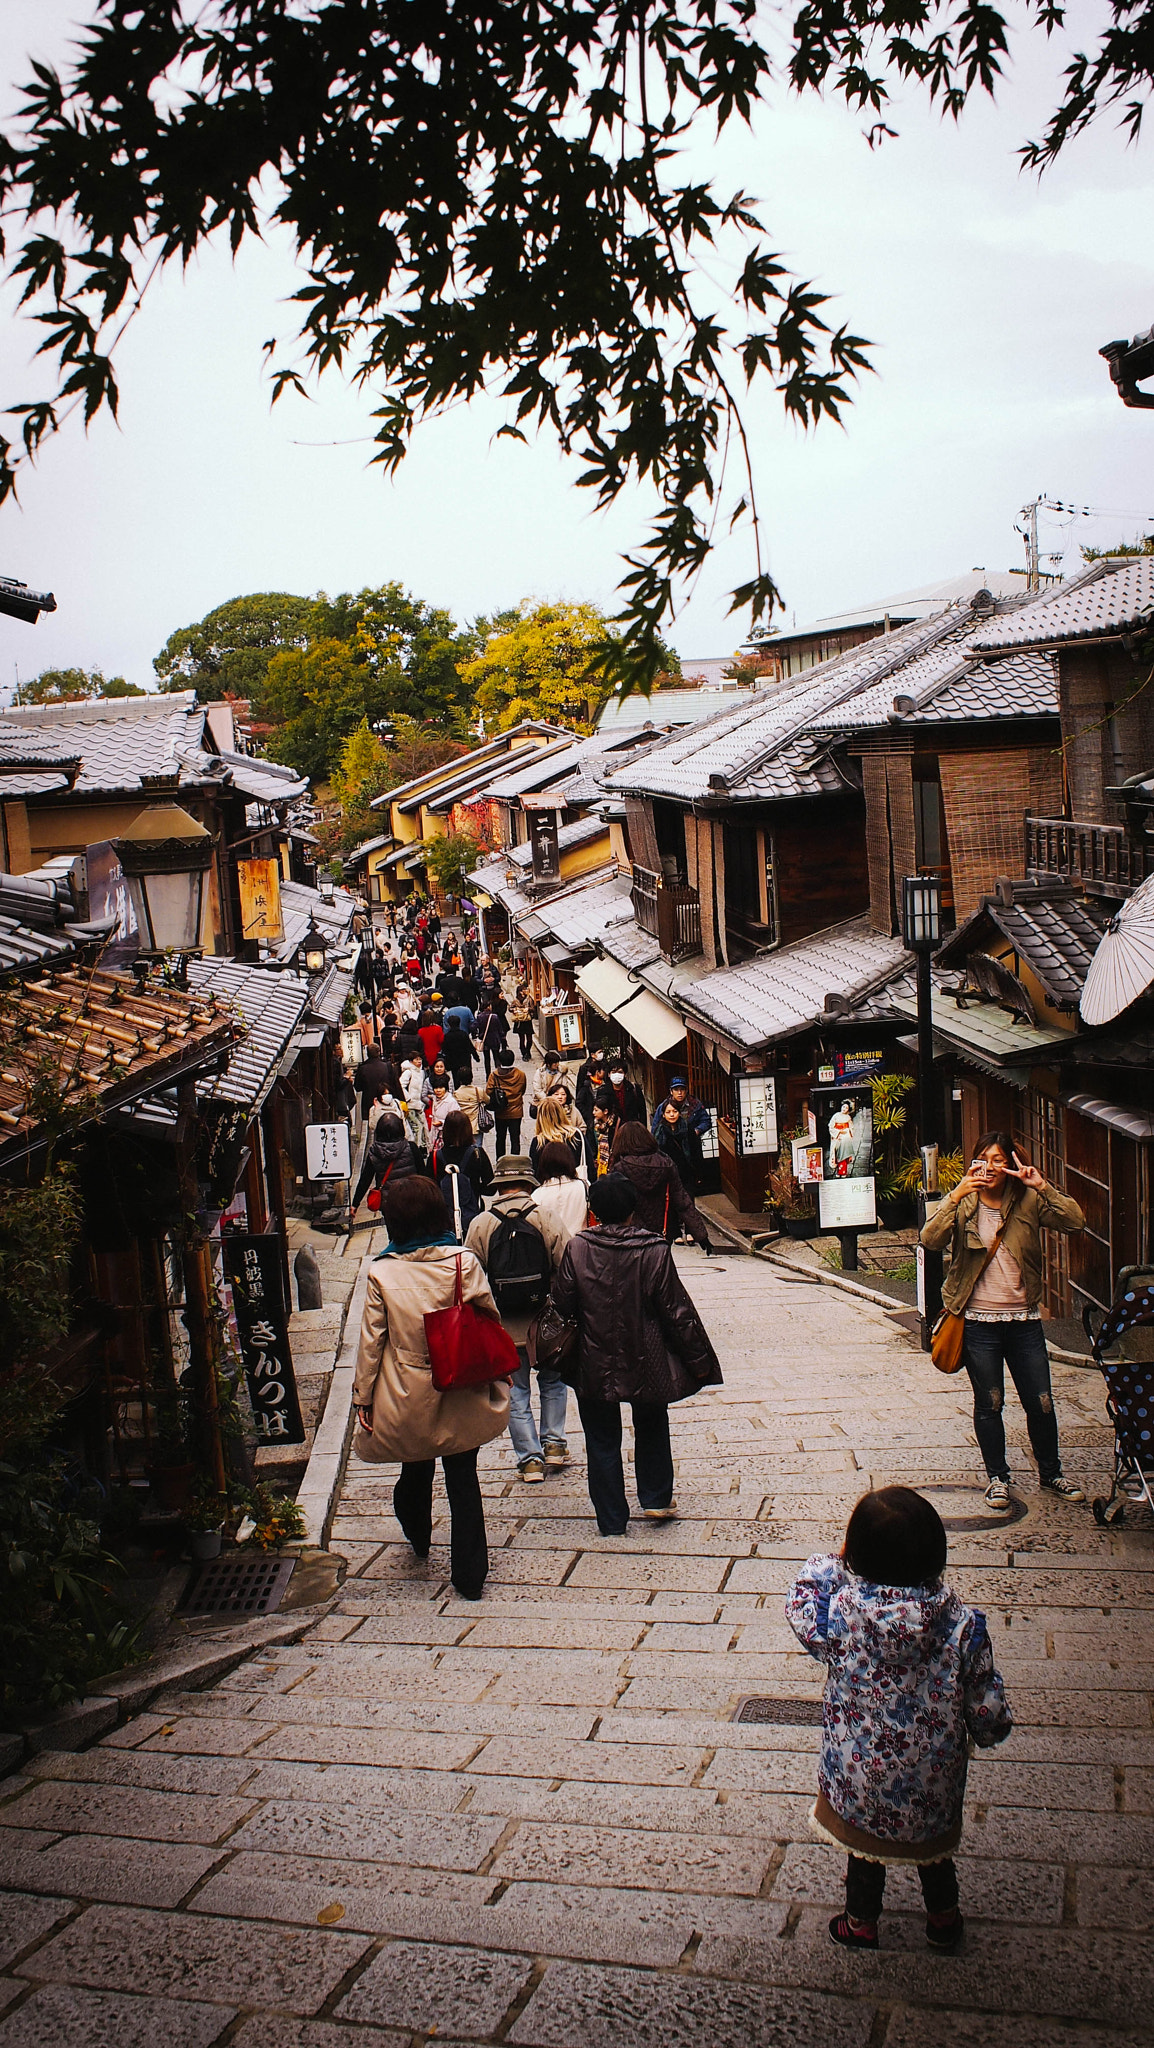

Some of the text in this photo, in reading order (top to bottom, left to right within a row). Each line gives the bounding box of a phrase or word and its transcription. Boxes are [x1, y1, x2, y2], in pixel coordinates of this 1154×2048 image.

[765, 1083, 774, 1111] そば処
[743, 1116, 757, 1148] ふたば
